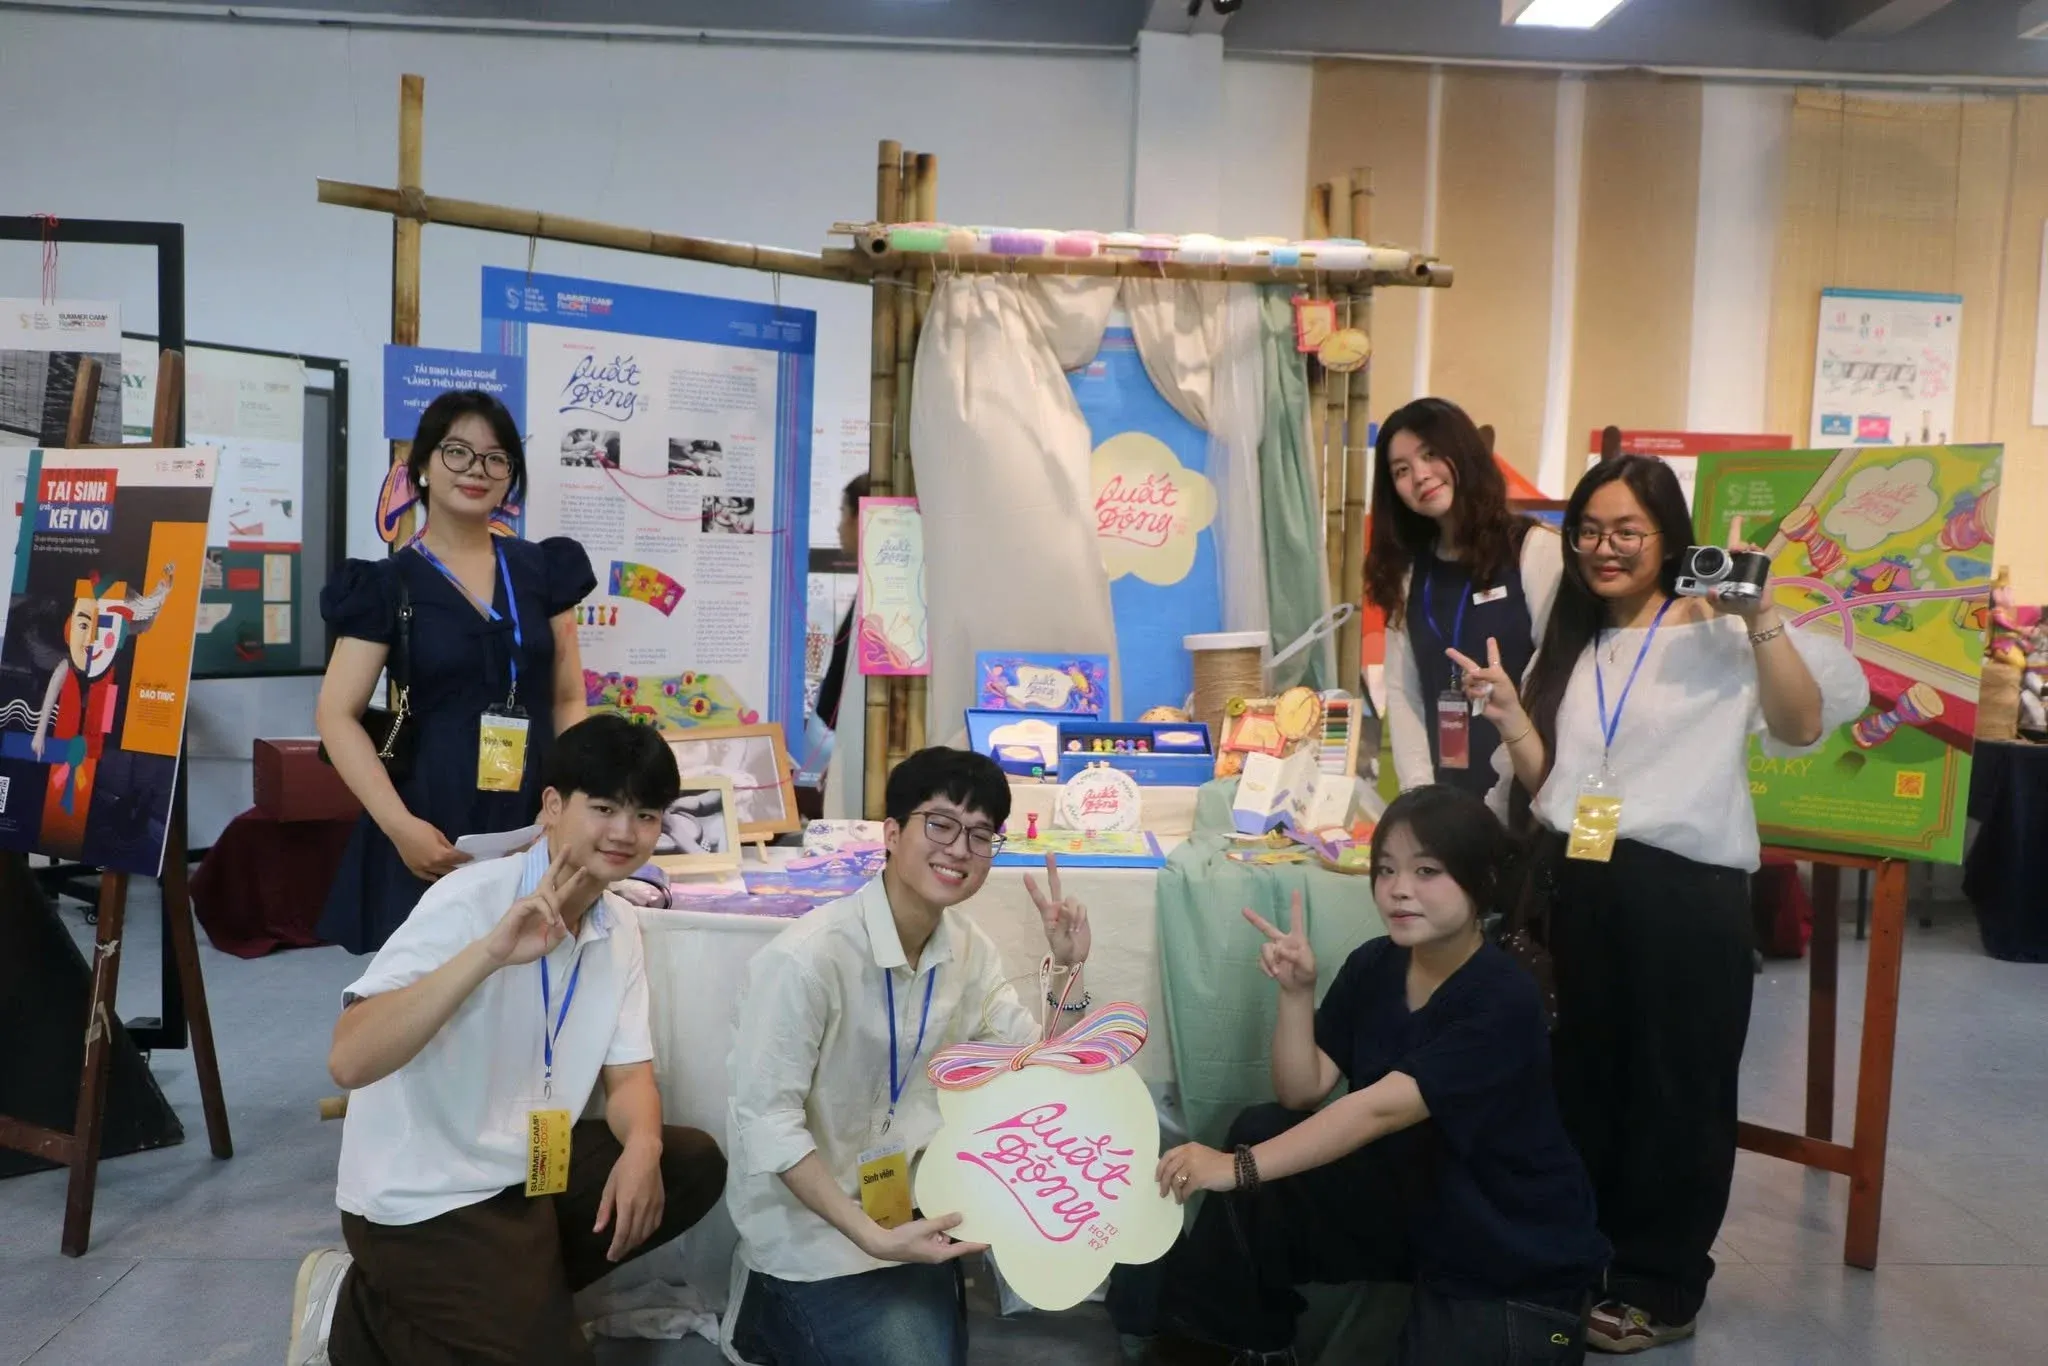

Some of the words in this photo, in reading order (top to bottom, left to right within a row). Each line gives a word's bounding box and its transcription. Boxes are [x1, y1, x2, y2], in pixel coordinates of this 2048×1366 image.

[73, 480, 108, 502] SINH
[532, 1115, 541, 1145] CAMP
[530, 1146, 540, 1192] SUMMER
[863, 1171, 879, 1185] Sinh
[1088, 1224, 1109, 1244] HOA
